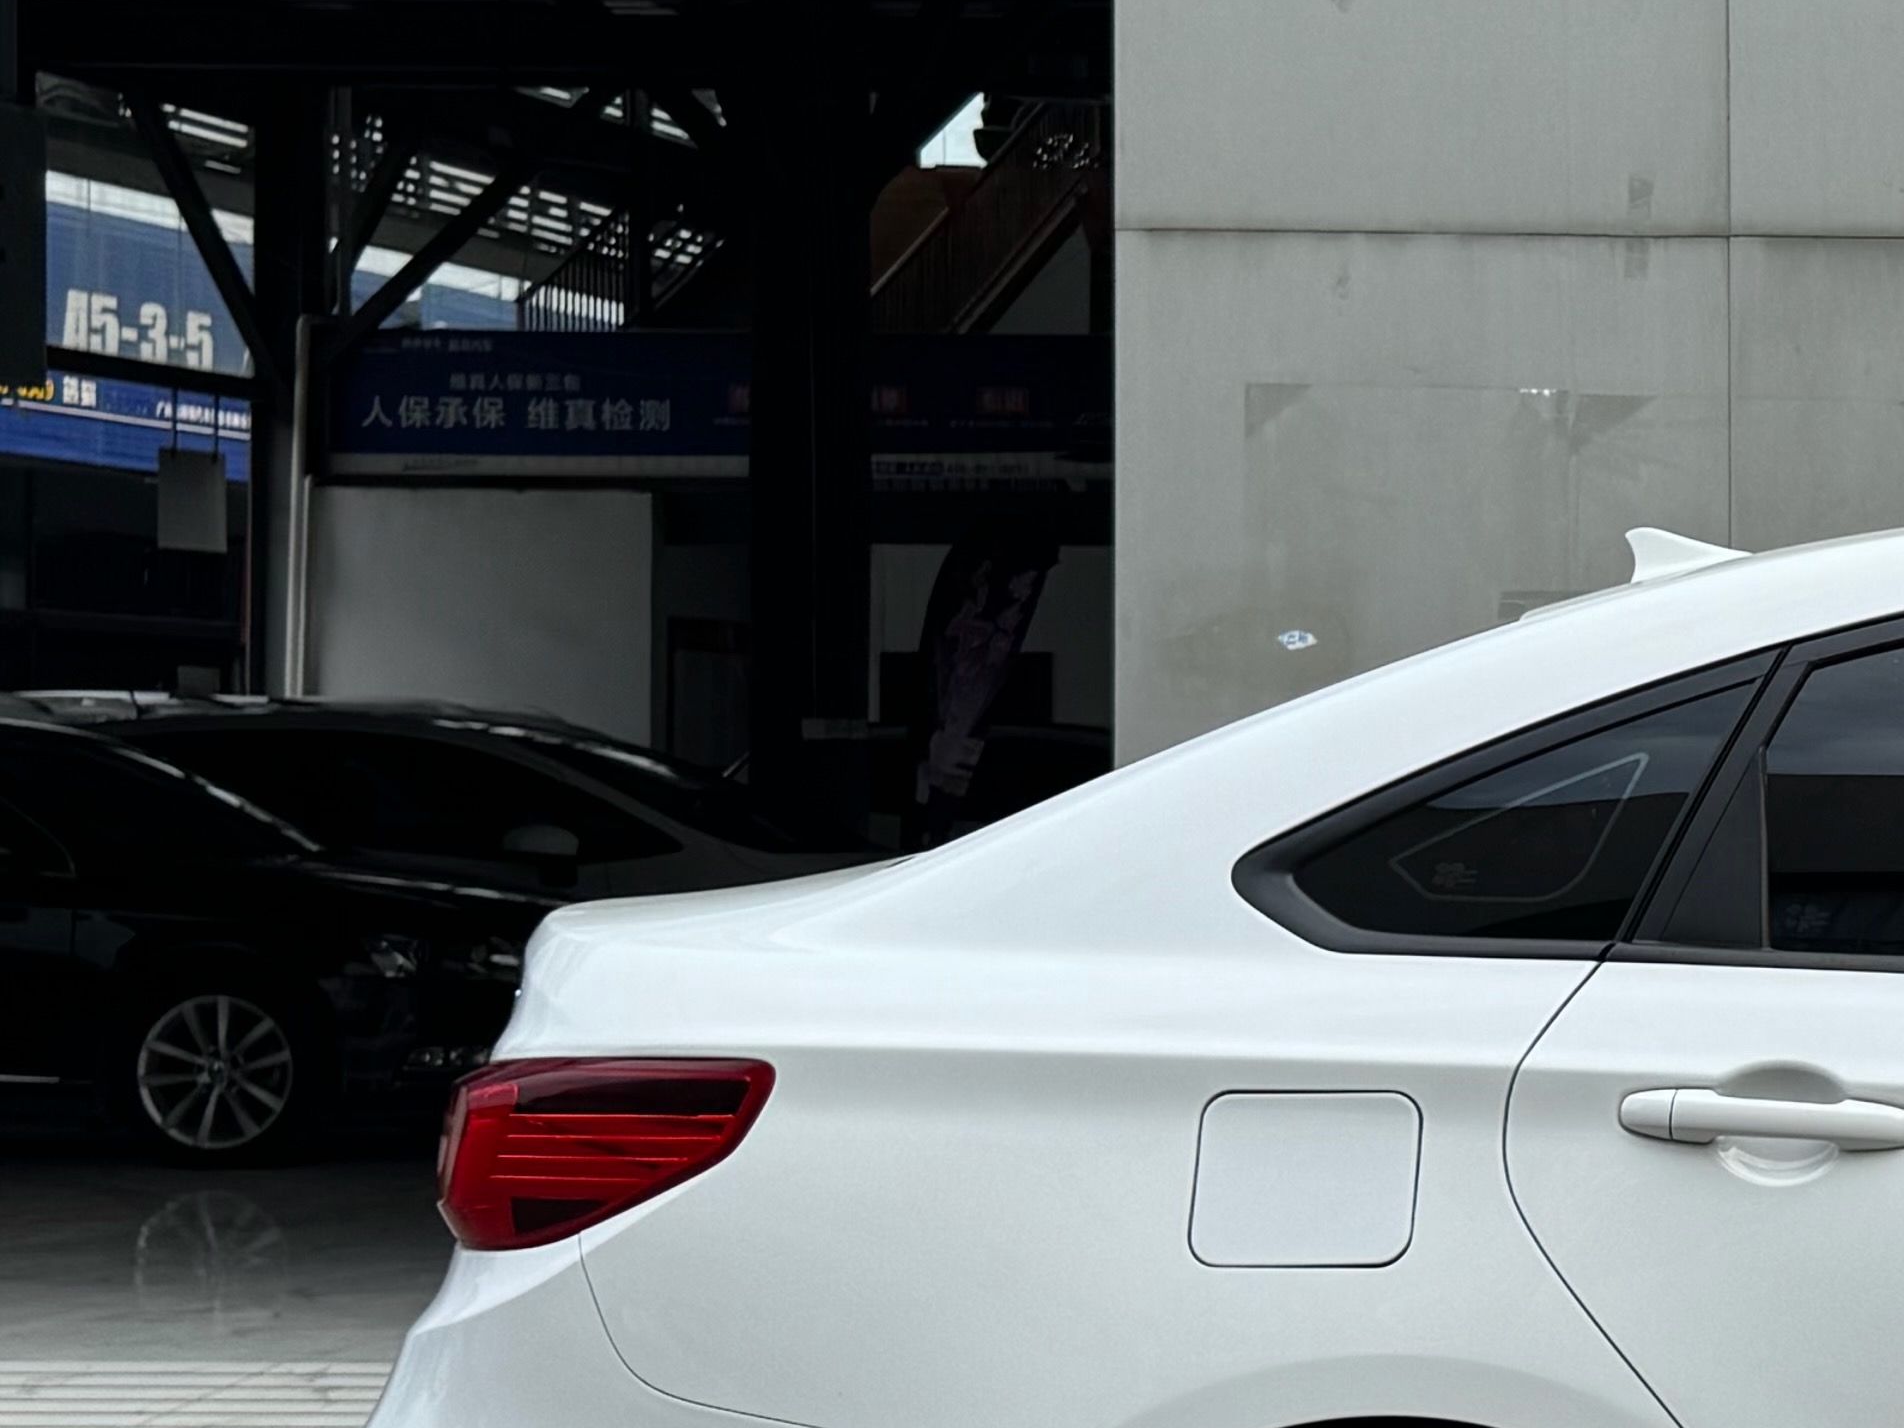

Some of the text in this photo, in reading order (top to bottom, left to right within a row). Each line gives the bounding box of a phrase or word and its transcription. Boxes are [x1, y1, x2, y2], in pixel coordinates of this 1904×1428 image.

[360, 394, 673, 433] 人保承保 维真检测
